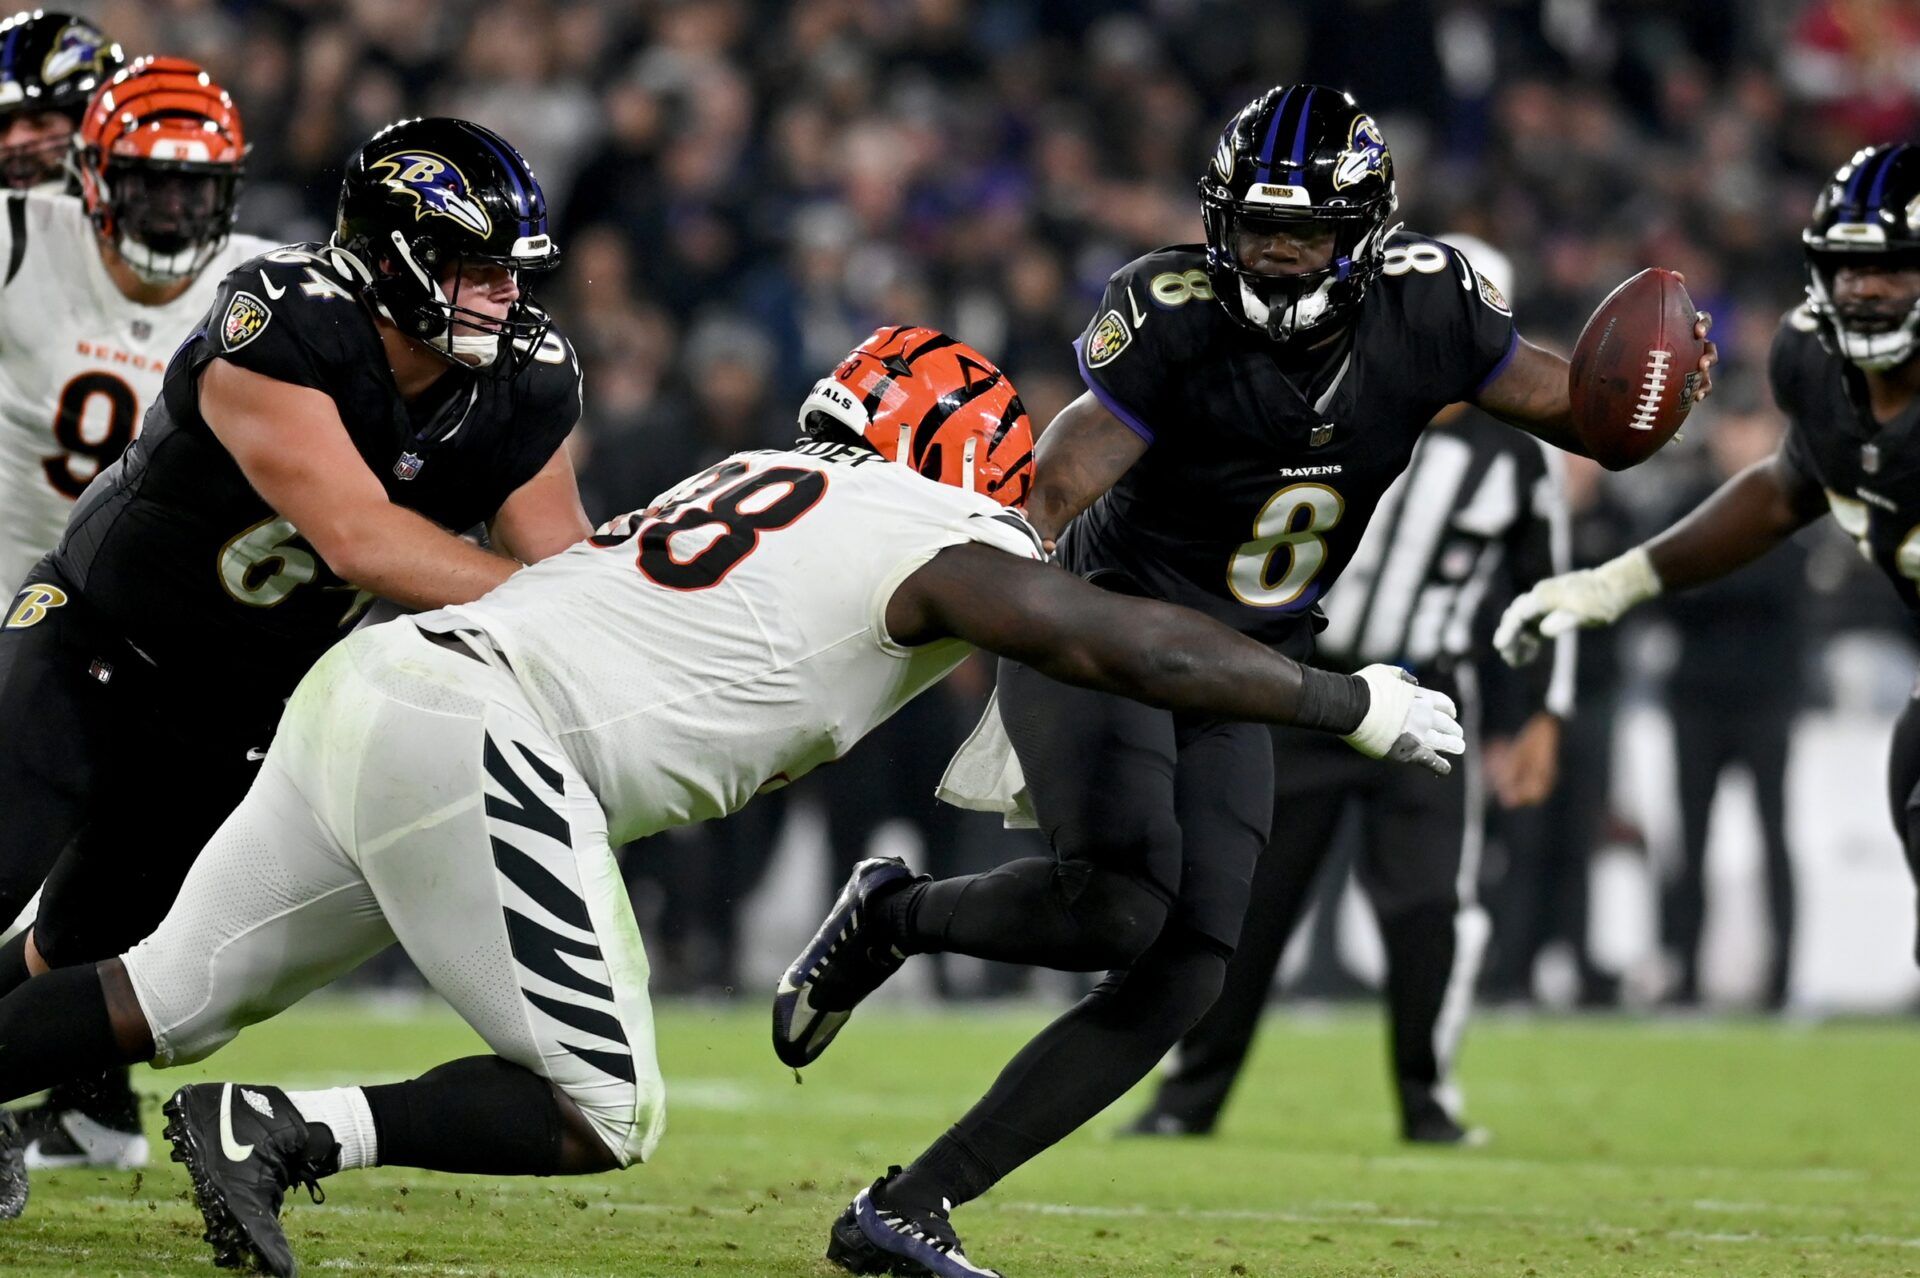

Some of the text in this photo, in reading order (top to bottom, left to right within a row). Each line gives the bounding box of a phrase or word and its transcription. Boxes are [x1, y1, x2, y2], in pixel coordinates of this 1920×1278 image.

[400, 155, 446, 183] B
[1261, 186, 1294, 198] RAVENS
[1383, 242, 1448, 276] 8
[1149, 268, 1214, 307] 8
[237, 295, 266, 318] RAVENS
[76, 340, 166, 374] BENGA
[838, 359, 862, 381] 8
[1279, 464, 1343, 478] RAVENS
[1226, 481, 1345, 607] 8
[5, 583, 68, 629] B
